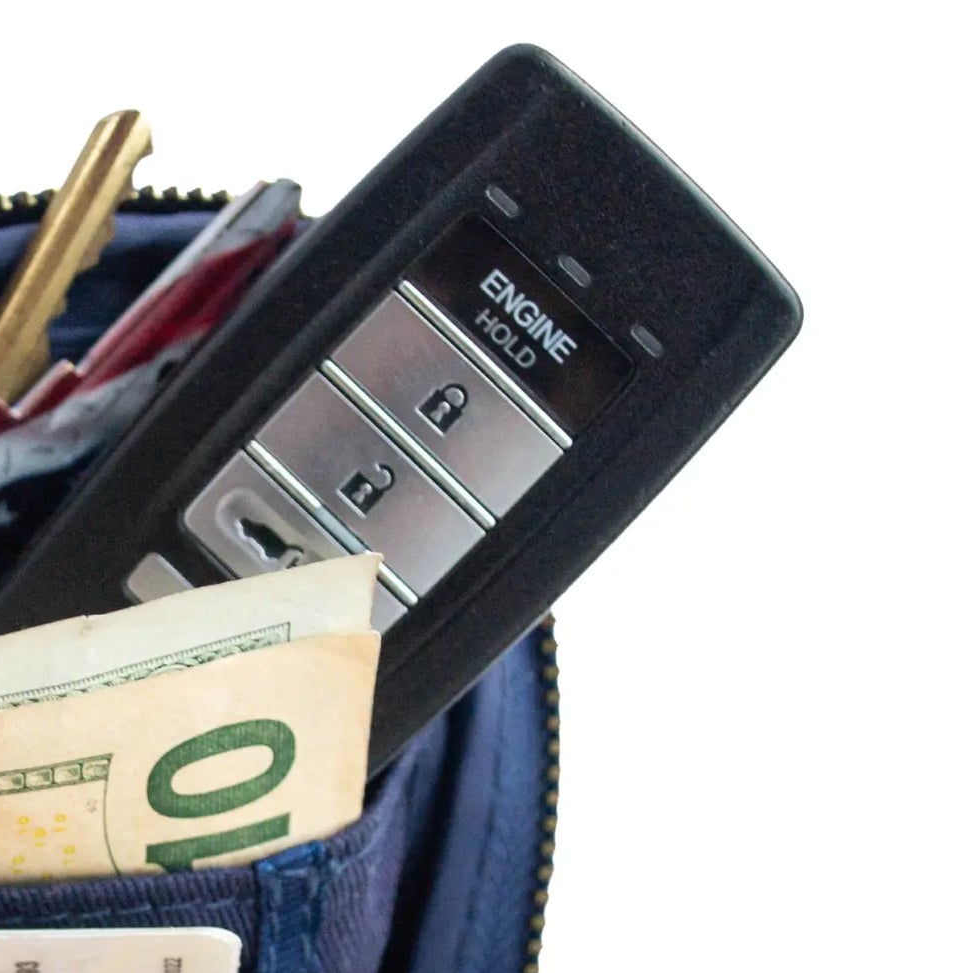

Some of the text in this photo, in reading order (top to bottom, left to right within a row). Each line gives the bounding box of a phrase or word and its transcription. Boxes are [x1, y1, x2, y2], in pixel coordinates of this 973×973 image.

[474, 308, 537, 369] HOLD
[479, 268, 578, 365] ENGINE
[146, 719, 296, 873] 10
